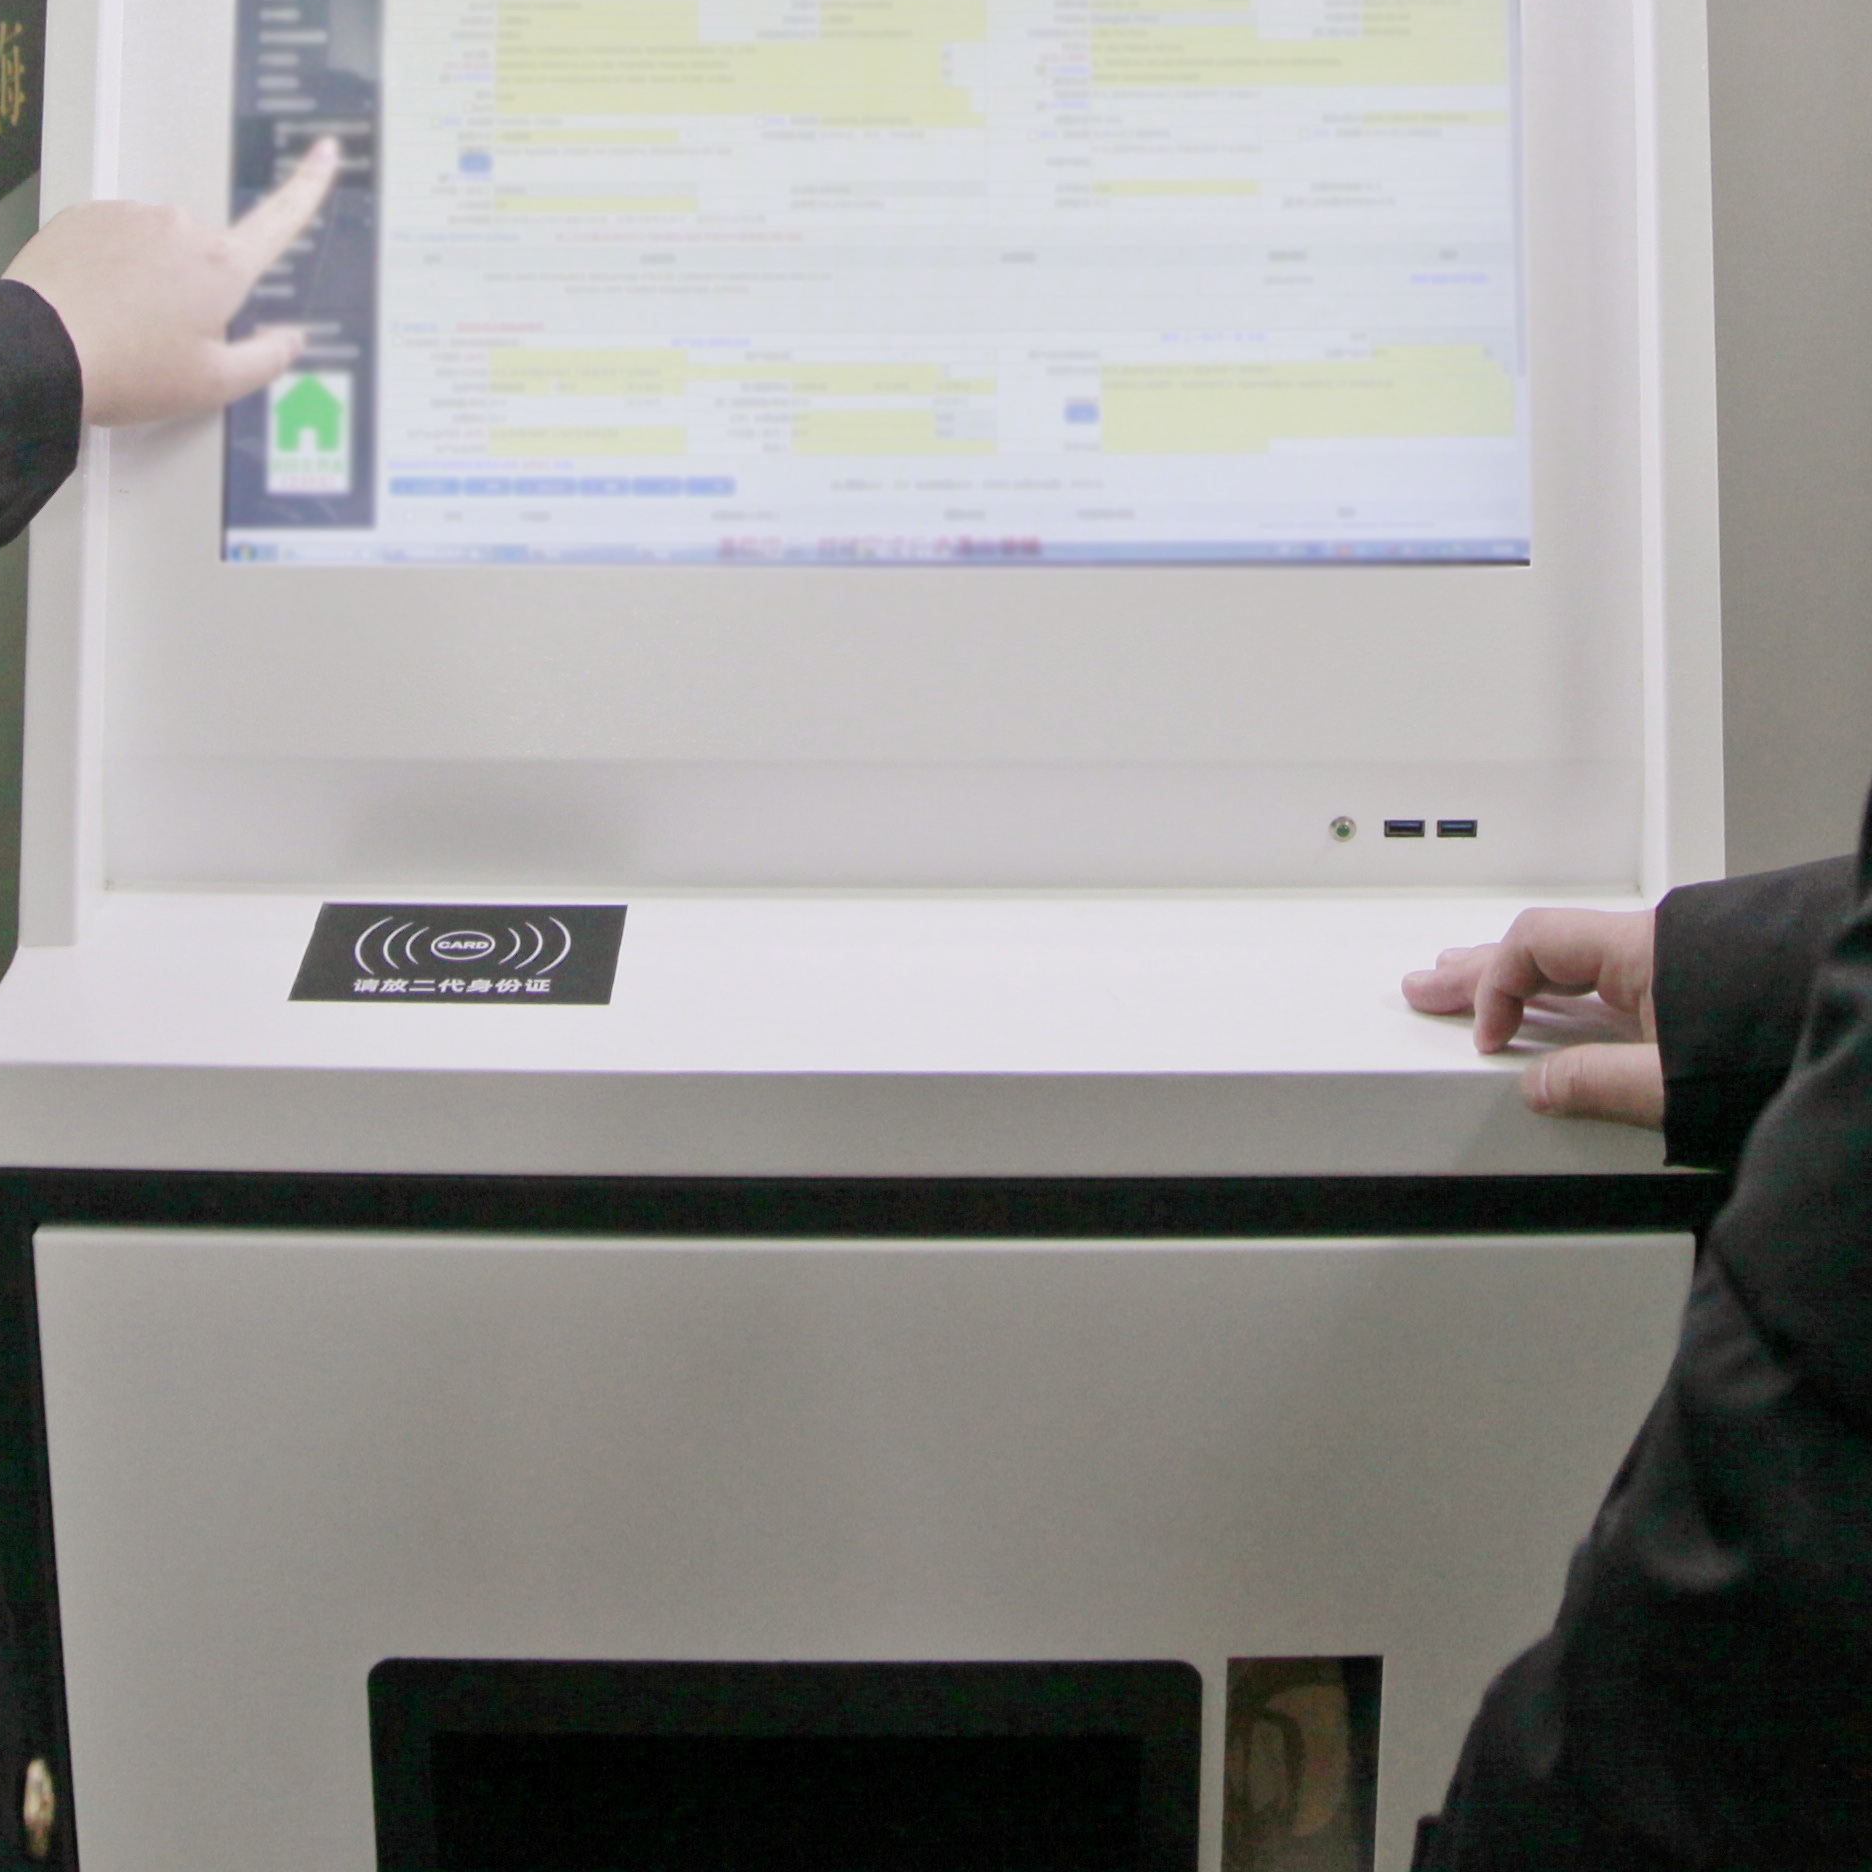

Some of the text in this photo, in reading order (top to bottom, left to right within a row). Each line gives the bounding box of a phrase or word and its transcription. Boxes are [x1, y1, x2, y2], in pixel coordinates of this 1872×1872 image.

[437, 940, 490, 950] CARD
[353, 978, 551, 994] 请放二代身份证
